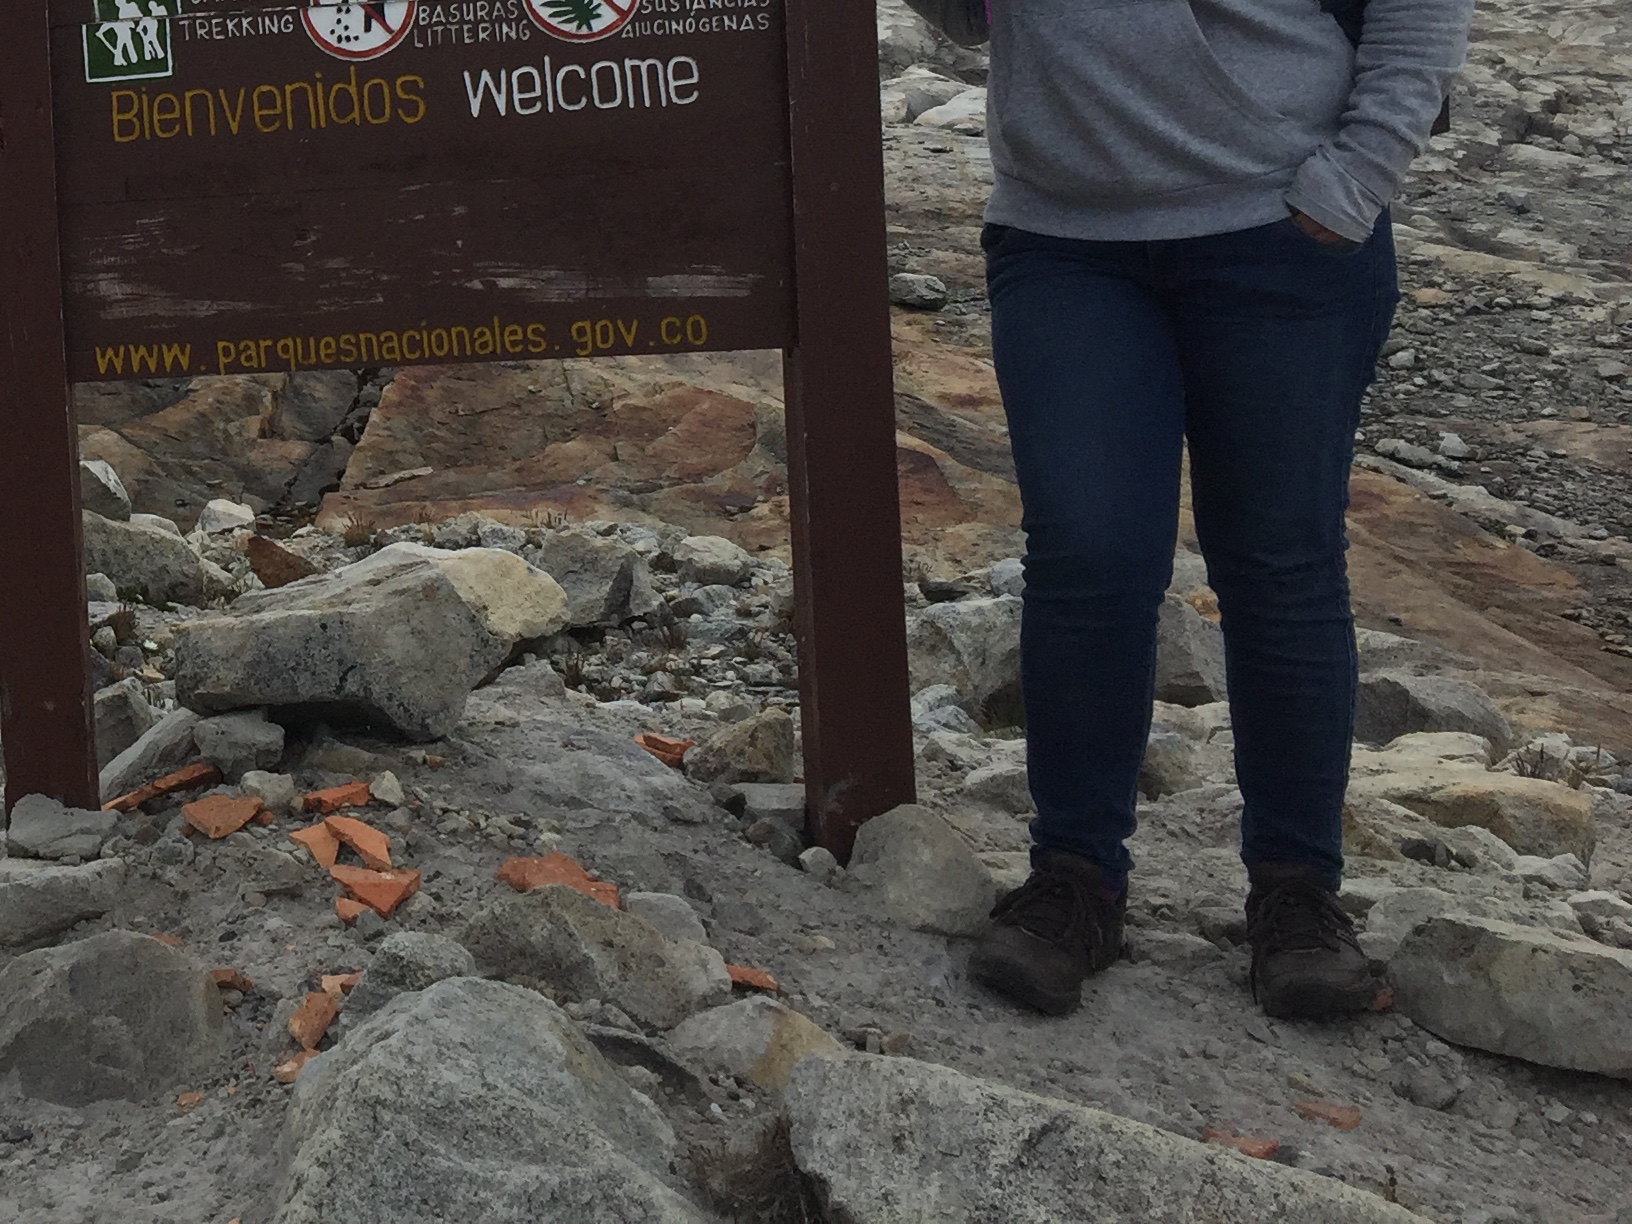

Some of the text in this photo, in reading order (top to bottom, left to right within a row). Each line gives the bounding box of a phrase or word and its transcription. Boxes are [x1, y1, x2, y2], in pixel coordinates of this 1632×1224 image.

[179, 13, 295, 40] TREKKING
[417, 0, 519, 25] BASURAS
[412, 19, 532, 50] LITTERING
[111, 64, 426, 143] Bienvenidos
